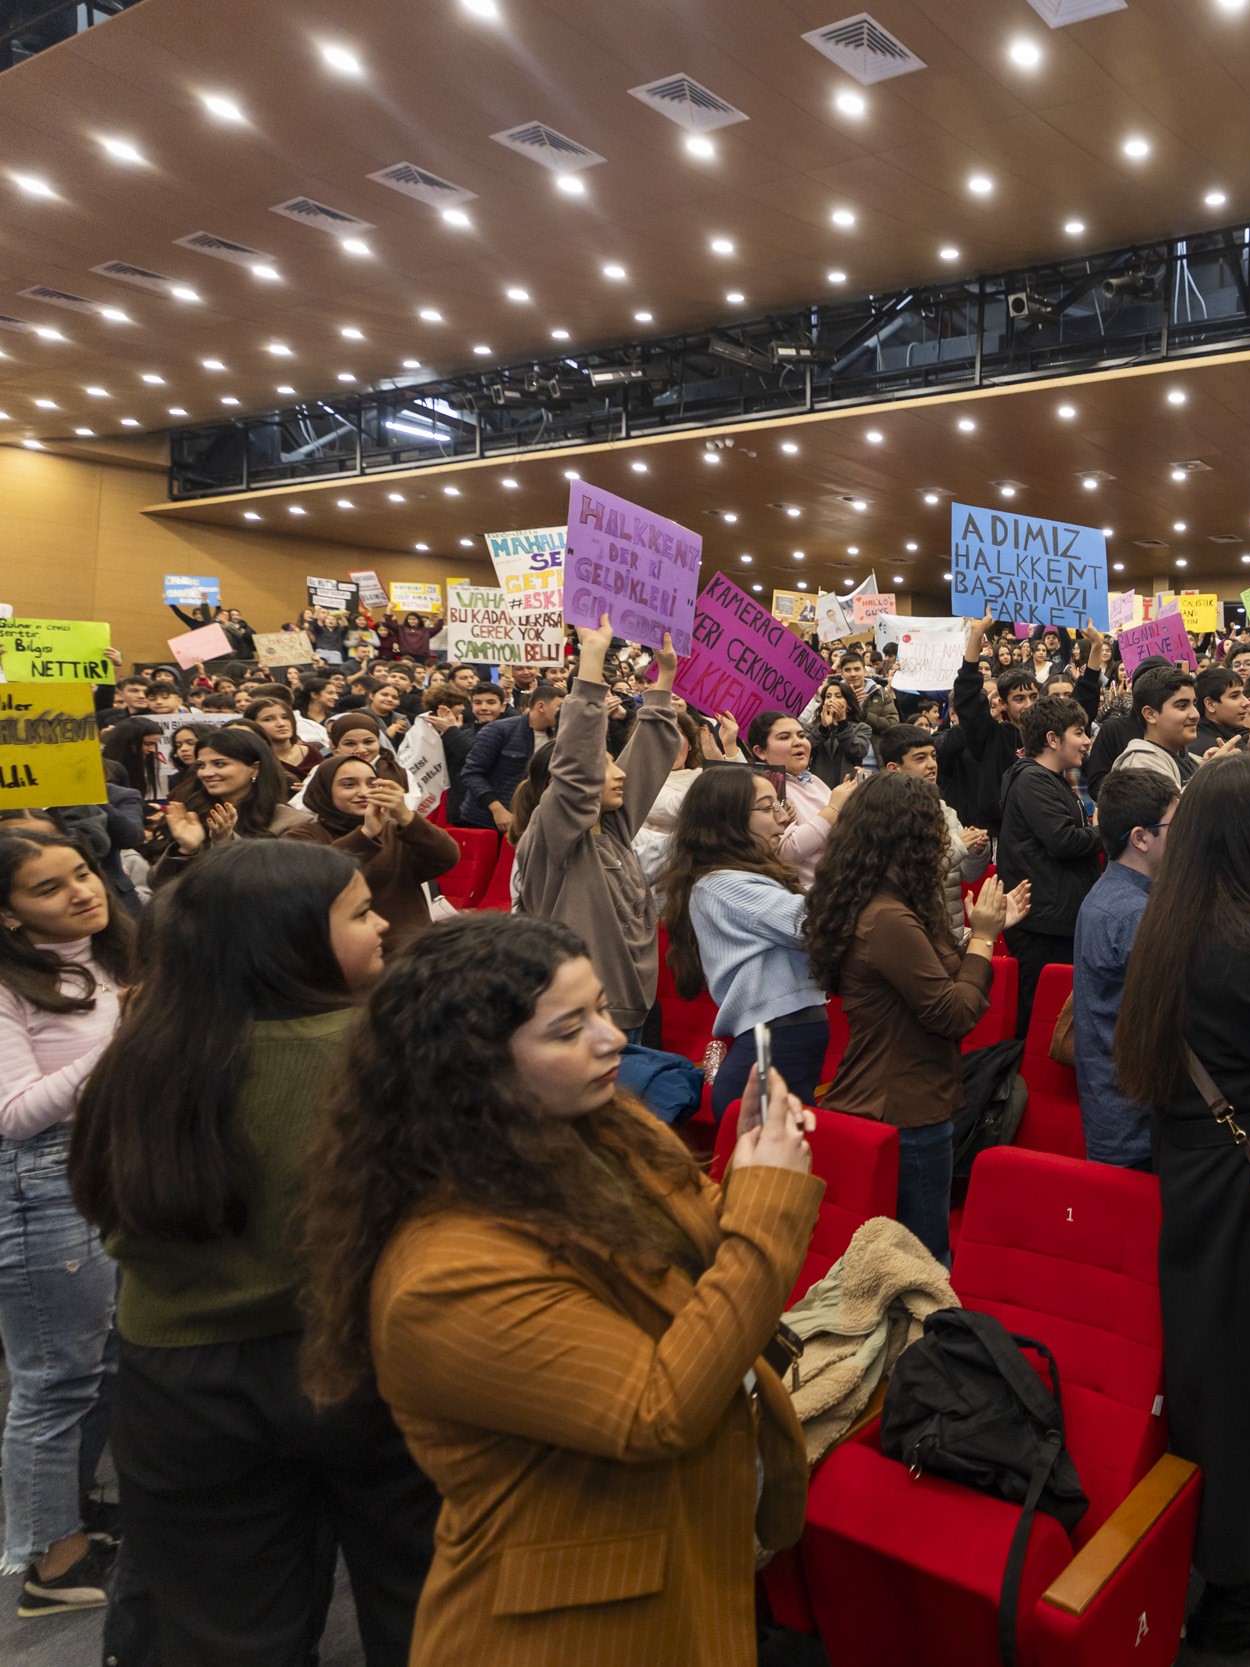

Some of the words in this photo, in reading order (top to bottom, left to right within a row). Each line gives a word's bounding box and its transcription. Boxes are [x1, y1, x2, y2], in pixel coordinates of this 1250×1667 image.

[490, 532, 566, 557] MAHALL
[580, 495, 700, 572] HALKKENT
[962, 512, 1081, 560] ADIMIZ
[529, 551, 562, 571] SE
[608, 542, 639, 571] DER
[955, 542, 1103, 589] HALKKENT
[505, 569, 563, 594] GETİ
[955, 571, 1087, 611] BAŞARIMIZI
[450, 608, 468, 623] BU
[706, 577, 785, 647] KAMERACI
[862, 598, 888, 607] HALLO
[865, 607, 889, 617] GUYS
[471, 625, 514, 640] GEREK
[518, 627, 545, 642] YOK
[0, 694, 32, 711] iler
[652, 648, 762, 731] ALKKENT
[0, 716, 97, 745] ALKKENT
[1065, 1207, 1074, 1222] 1
[1135, 1611, 1149, 1648] A
